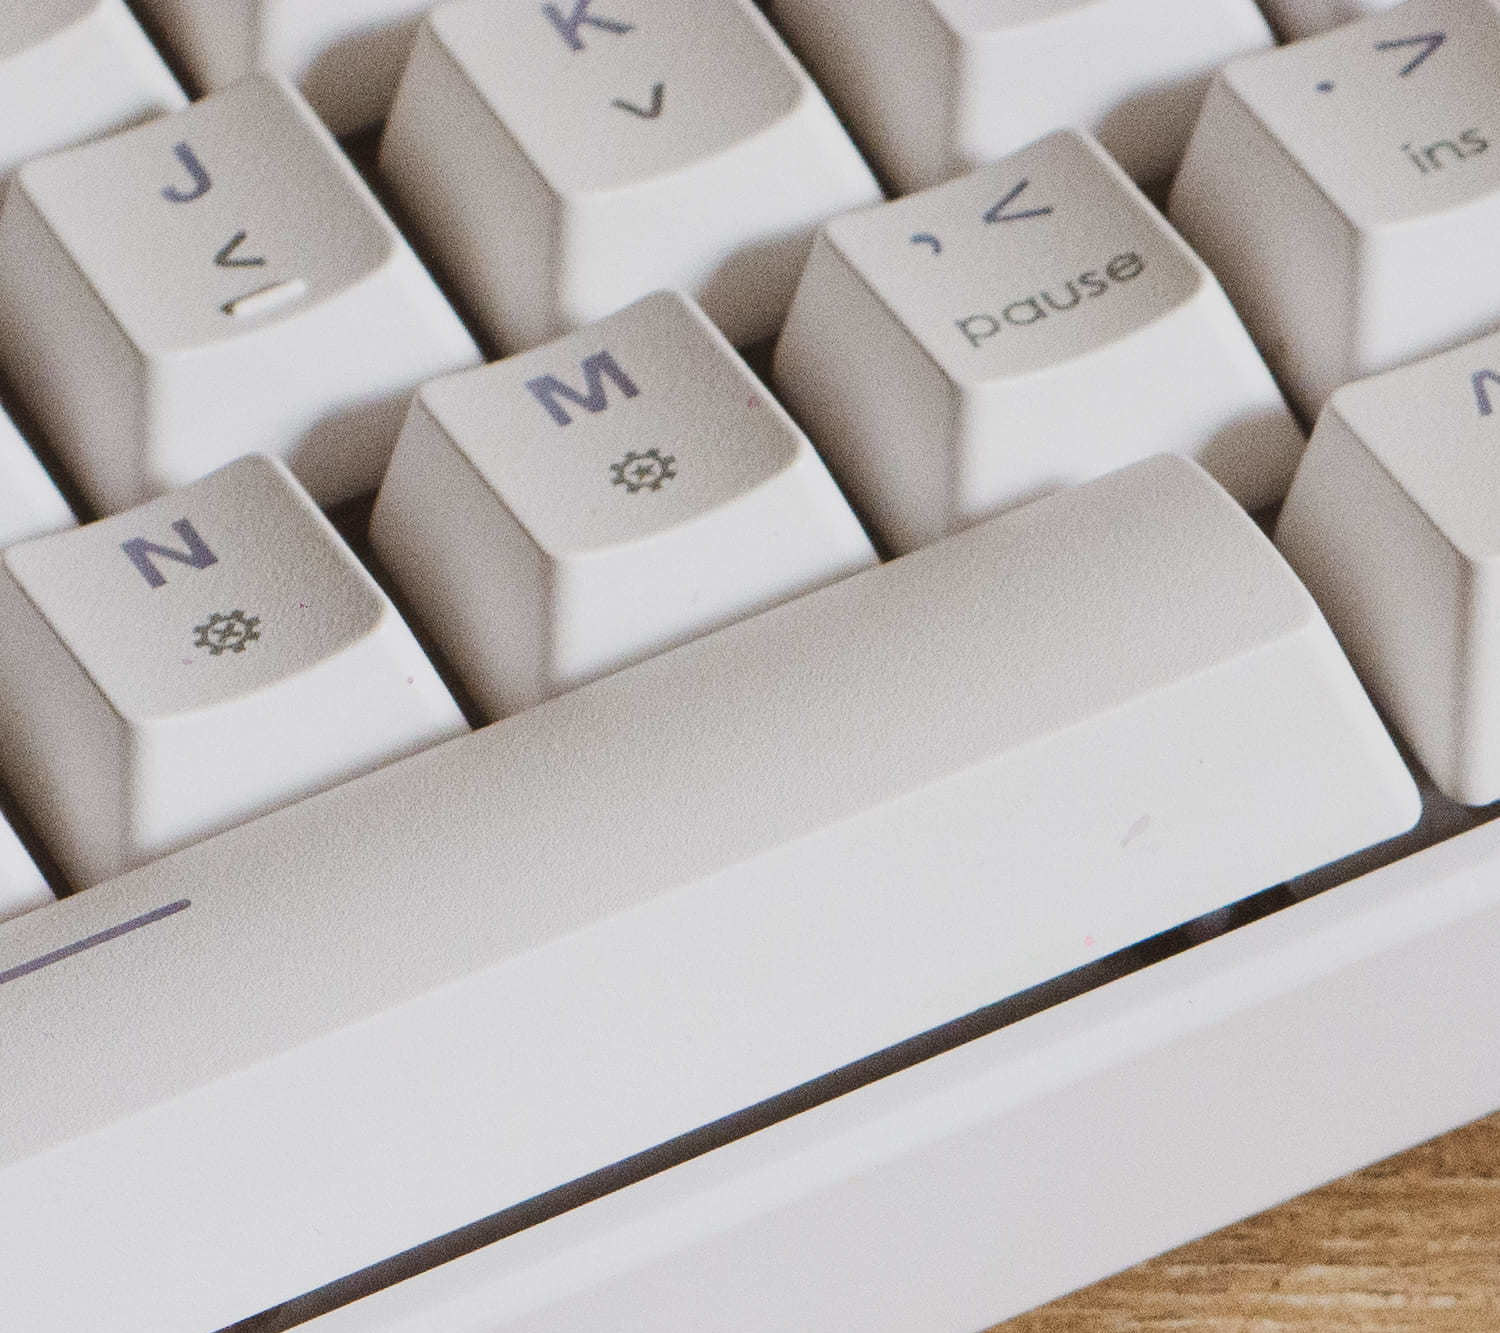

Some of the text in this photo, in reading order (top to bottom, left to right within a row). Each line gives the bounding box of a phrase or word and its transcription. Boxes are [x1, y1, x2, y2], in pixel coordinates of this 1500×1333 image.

[543, 0, 633, 51] K
[160, 142, 212, 203] J
[1403, 121, 1490, 175] ins
[956, 248, 1146, 348] pause
[524, 348, 640, 427] M
[120, 517, 219, 588] N
